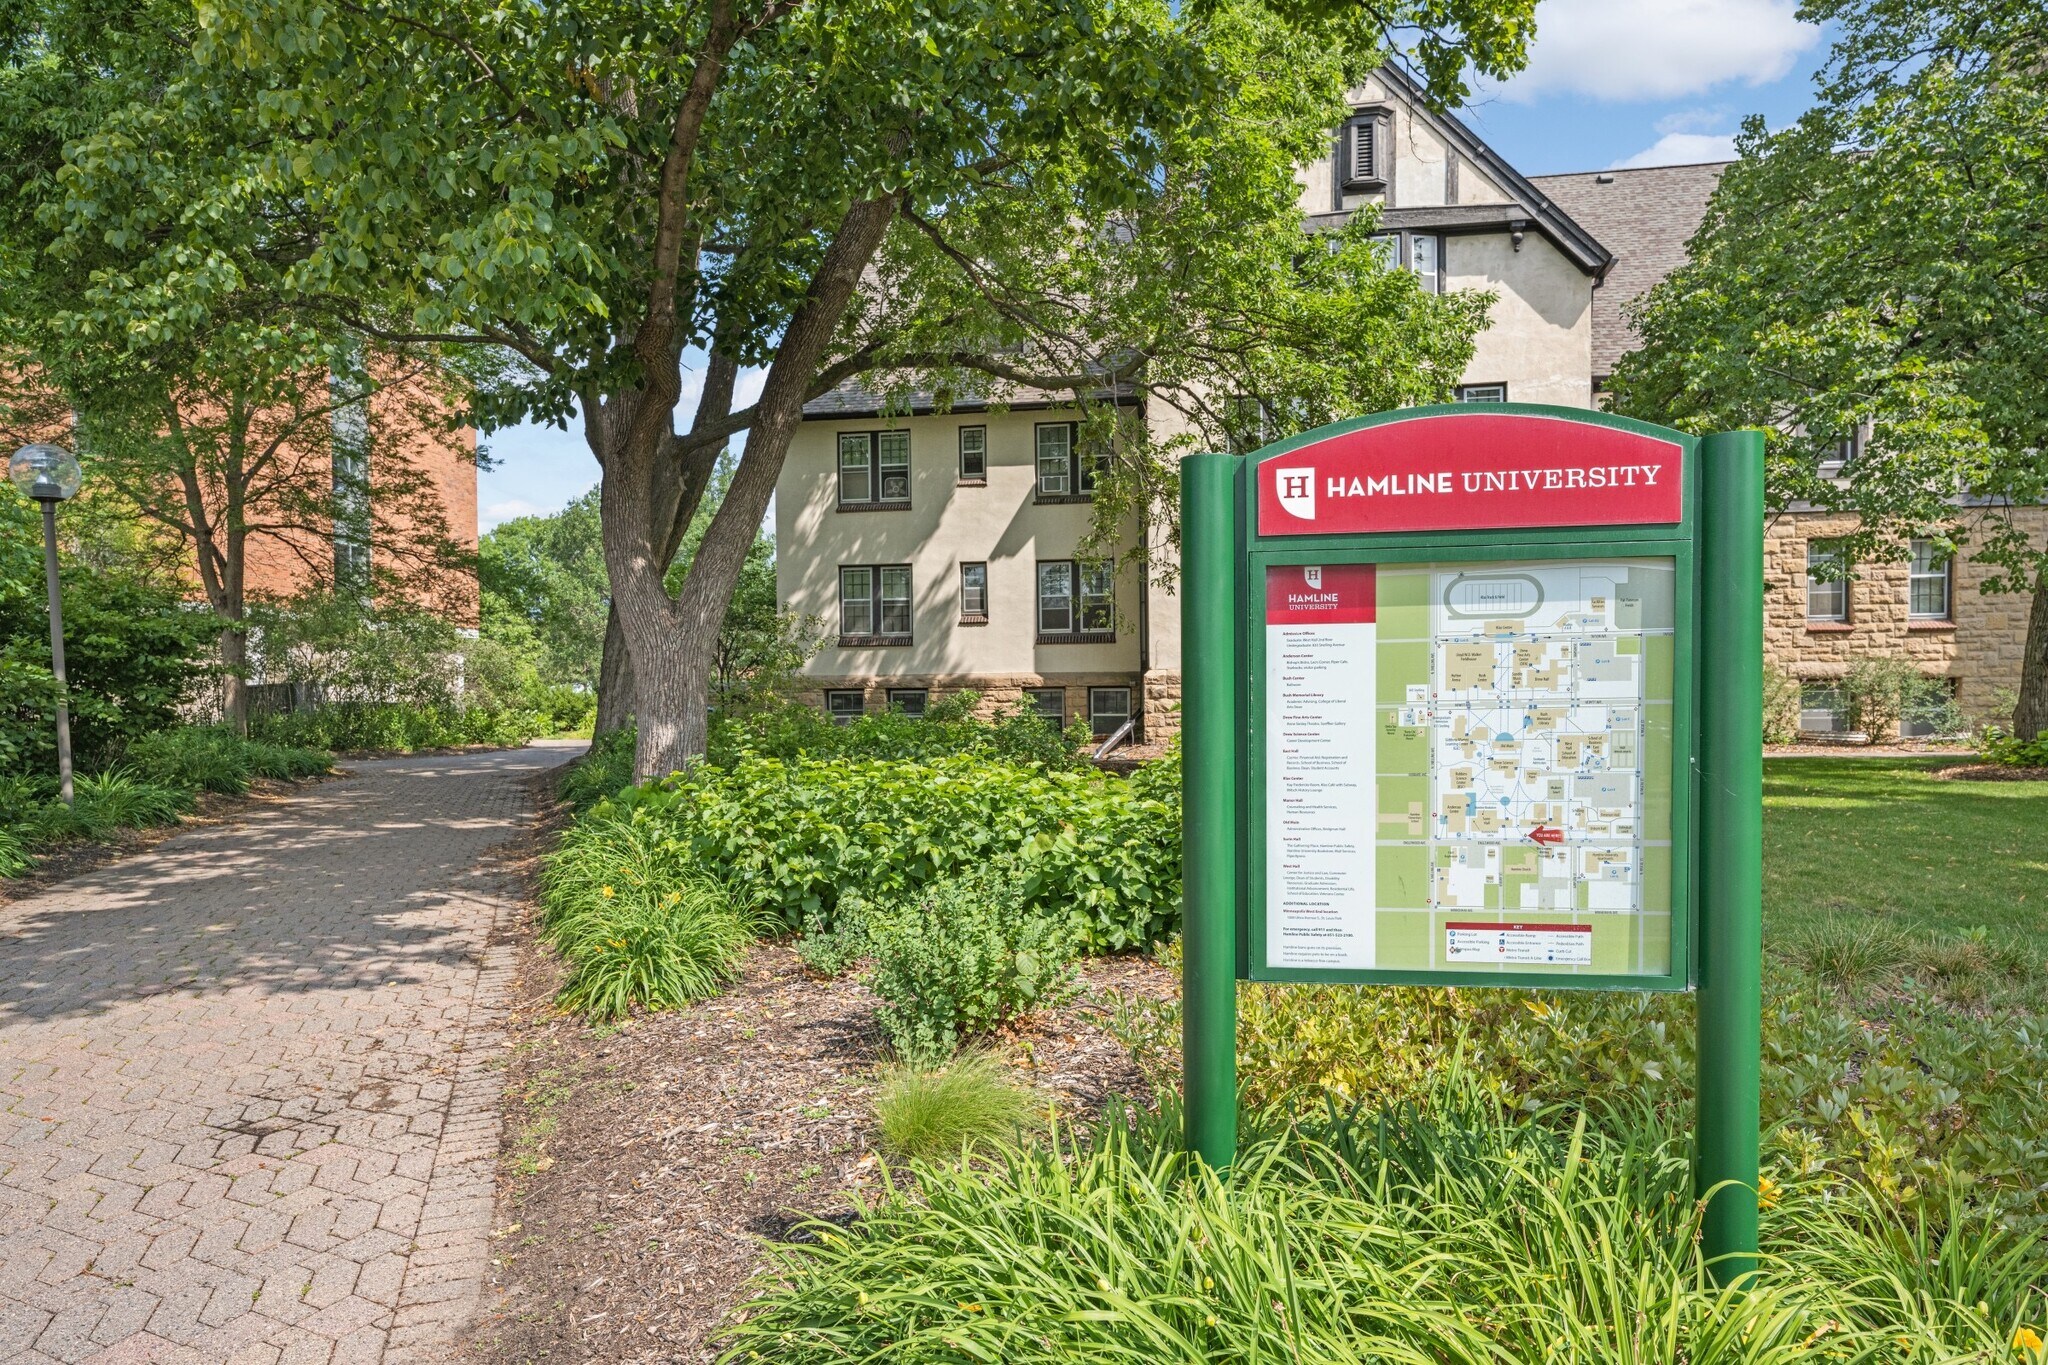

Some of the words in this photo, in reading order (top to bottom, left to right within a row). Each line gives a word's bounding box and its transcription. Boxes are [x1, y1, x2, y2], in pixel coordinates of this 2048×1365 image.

[1326, 472, 1453, 498] HAMLINE
[1462, 464, 1662, 492] UNIVERSITY
[1288, 593, 1338, 603] HAMLINE
[1289, 603, 1338, 611] UNIVERSITY
